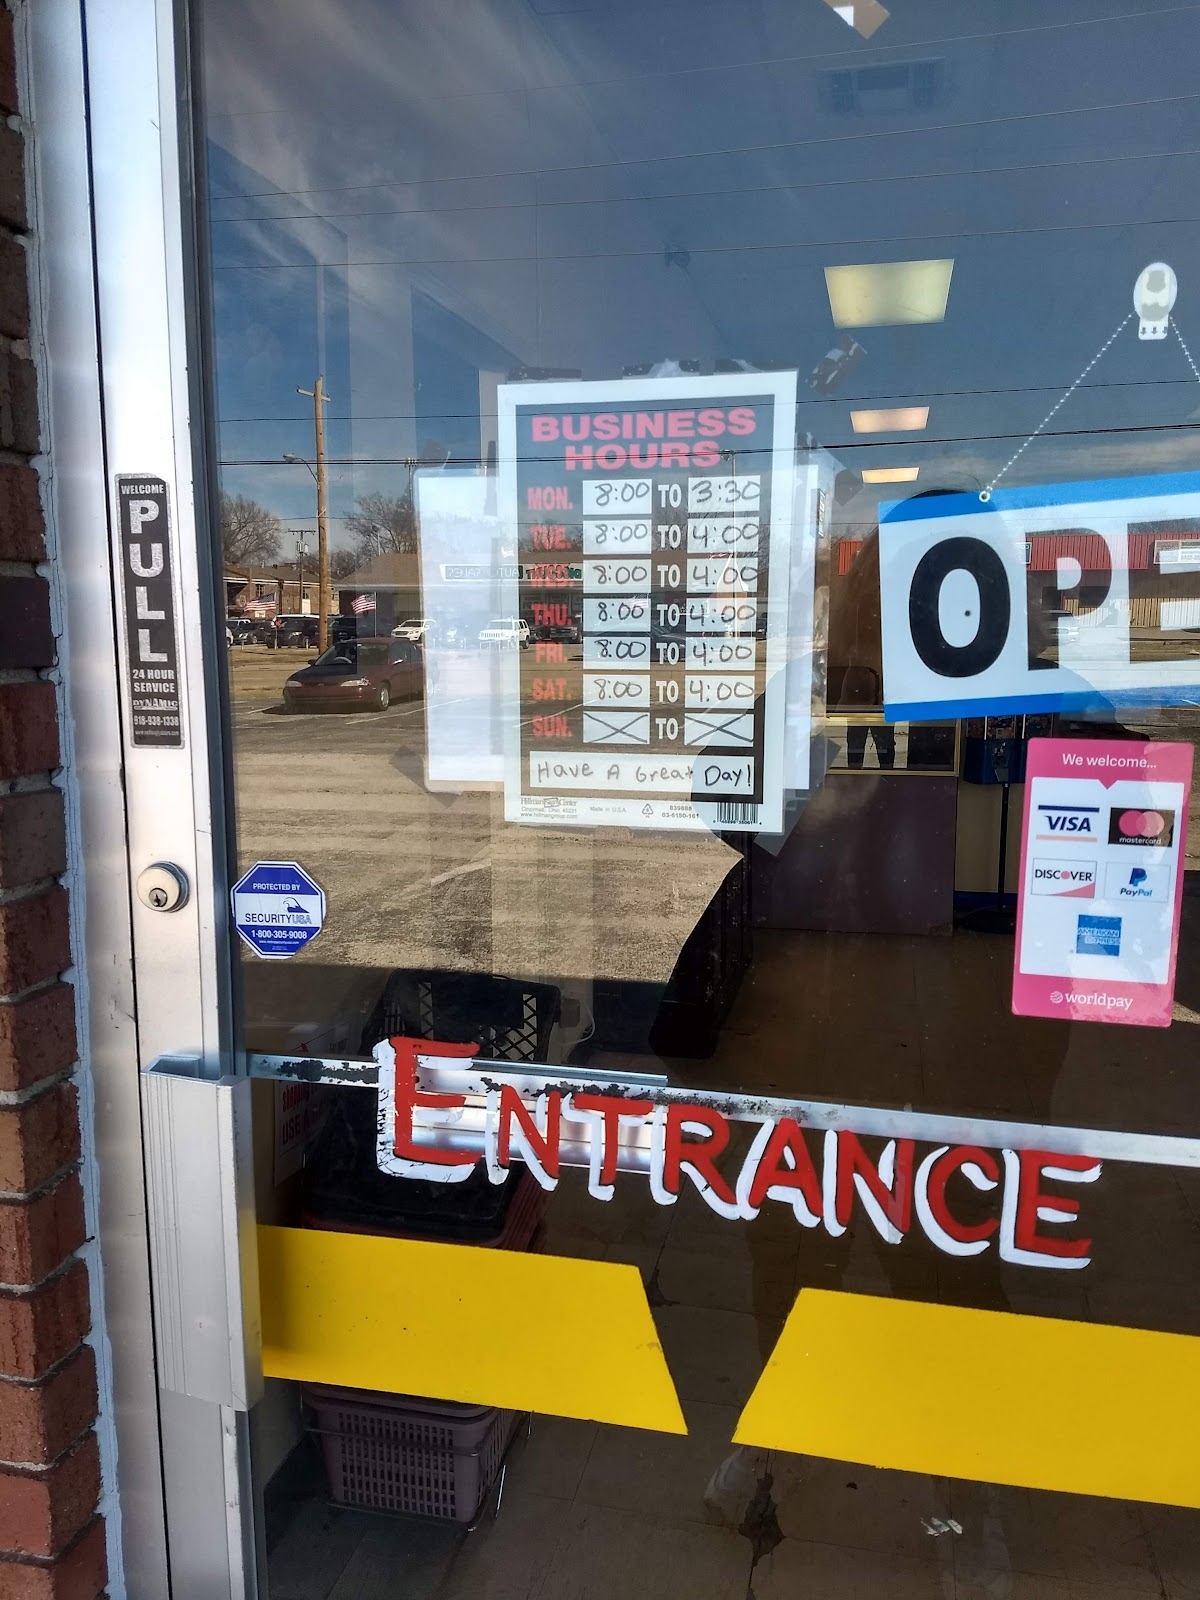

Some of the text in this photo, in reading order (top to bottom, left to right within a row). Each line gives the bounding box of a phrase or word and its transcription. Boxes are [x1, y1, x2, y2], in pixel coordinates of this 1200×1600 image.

[531, 408, 757, 442] BUSINESS
[564, 440, 721, 471] HOURS
[120, 484, 165, 495] WELCOME
[527, 480, 761, 511] MON. 8:00 TO 3:30
[530, 523, 760, 550] TUE. 8:00 TO 4:00
[128, 499, 168, 662] PULL
[592, 564, 648, 585] 8:00
[656, 564, 681, 588] TO
[692, 565, 759, 587] 4:00
[530, 601, 756, 627] THU. 8:00 TO 4:00
[535, 638, 752, 667] FRI. 8:00 TO 4:00
[132, 668, 175, 680] 24 HOUR
[133, 682, 176, 693] SERVICE
[532, 678, 754, 703] SAT. 8:00 TO 4:00
[132, 697, 179, 709] DYNAMIC
[531, 715, 679, 740] SUN. TO
[1062, 752, 1157, 769] We welcome...
[537, 761, 752, 788] Have A Great Day!
[1044, 815, 1162, 845] VISA mastercard
[252, 882, 301, 891] PROTECTED BY
[1034, 868, 1152, 897] DISCOVER PayPal
[1064, 991, 1133, 1010] worldpay
[376, 1036, 1103, 1269] ENTRANCE
